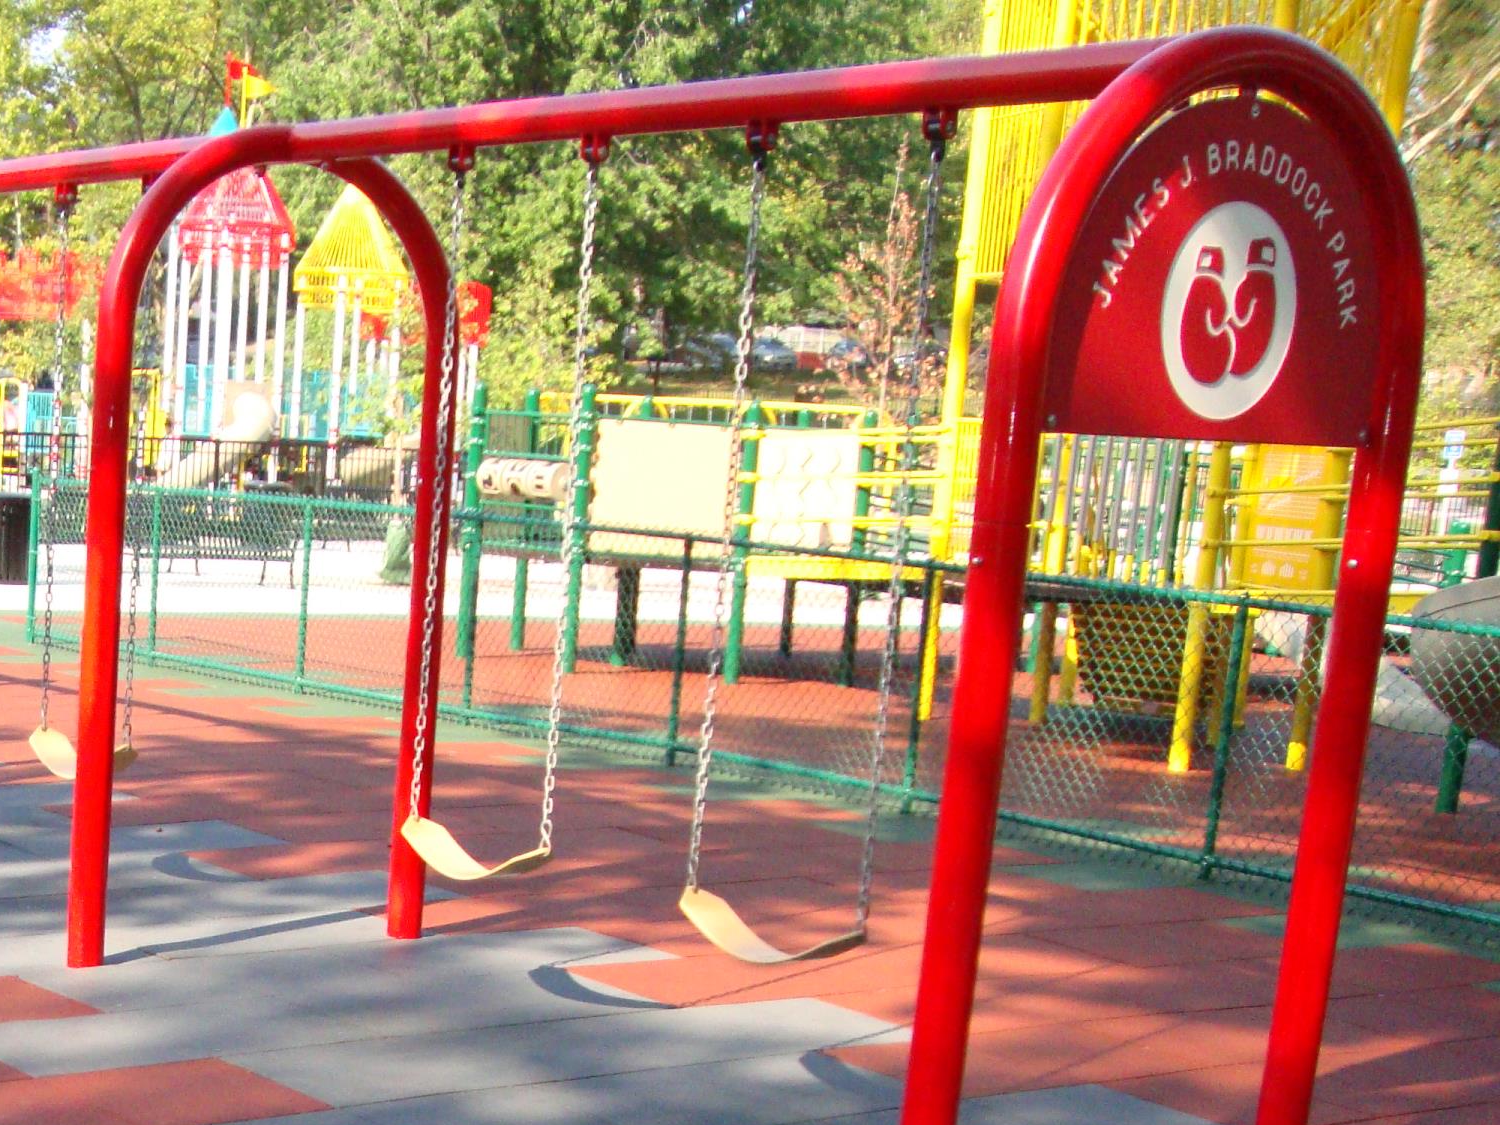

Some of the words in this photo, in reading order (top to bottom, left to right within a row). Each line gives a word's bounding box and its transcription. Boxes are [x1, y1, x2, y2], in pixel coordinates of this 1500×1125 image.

[1092, 177, 1170, 308] JAMES
[1207, 140, 1333, 230] BRADDOCK
[1327, 231, 1357, 329] PARK
